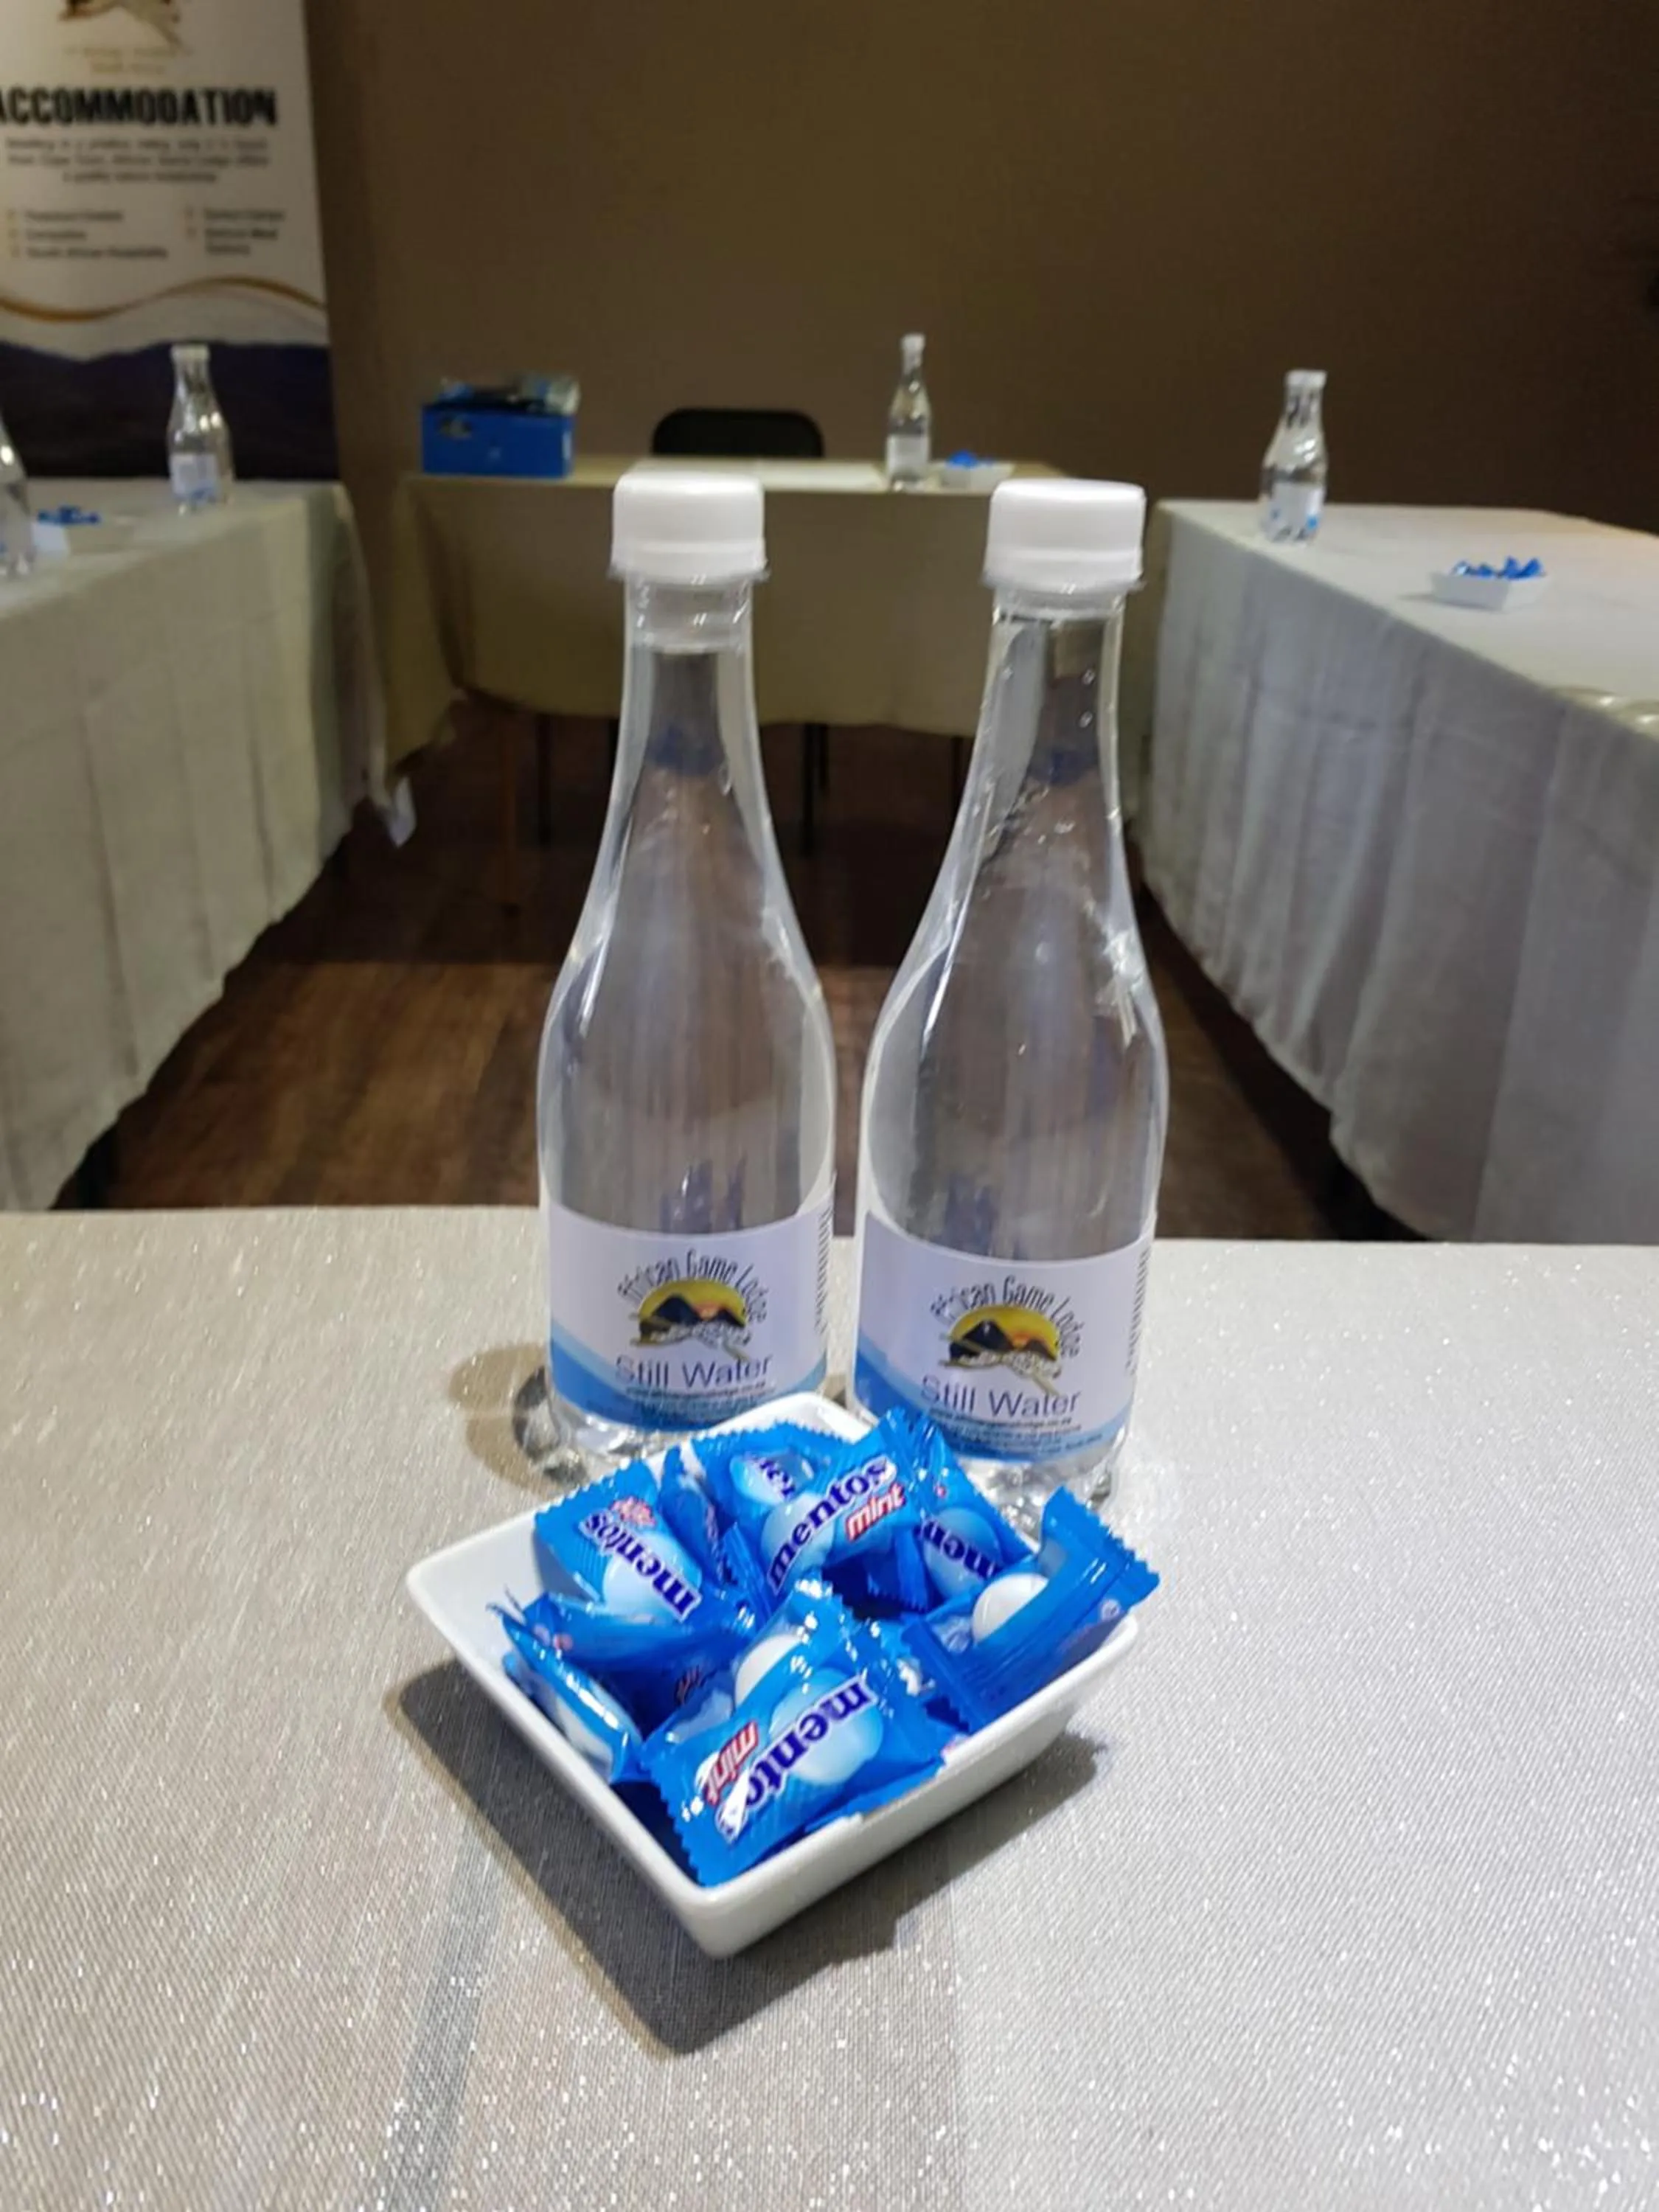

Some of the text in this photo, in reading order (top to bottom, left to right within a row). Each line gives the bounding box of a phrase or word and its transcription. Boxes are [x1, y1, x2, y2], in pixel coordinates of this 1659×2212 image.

[686, 1248, 738, 1284] Game
[1003, 1274, 1054, 1314] Game
[615, 1354, 669, 1389] Still
[681, 1354, 773, 1388] Water
[922, 1374, 976, 1413] Still
[988, 1390, 1082, 1425] Water
[767, 1457, 895, 1594] mentos
[845, 1481, 907, 1543] mint
